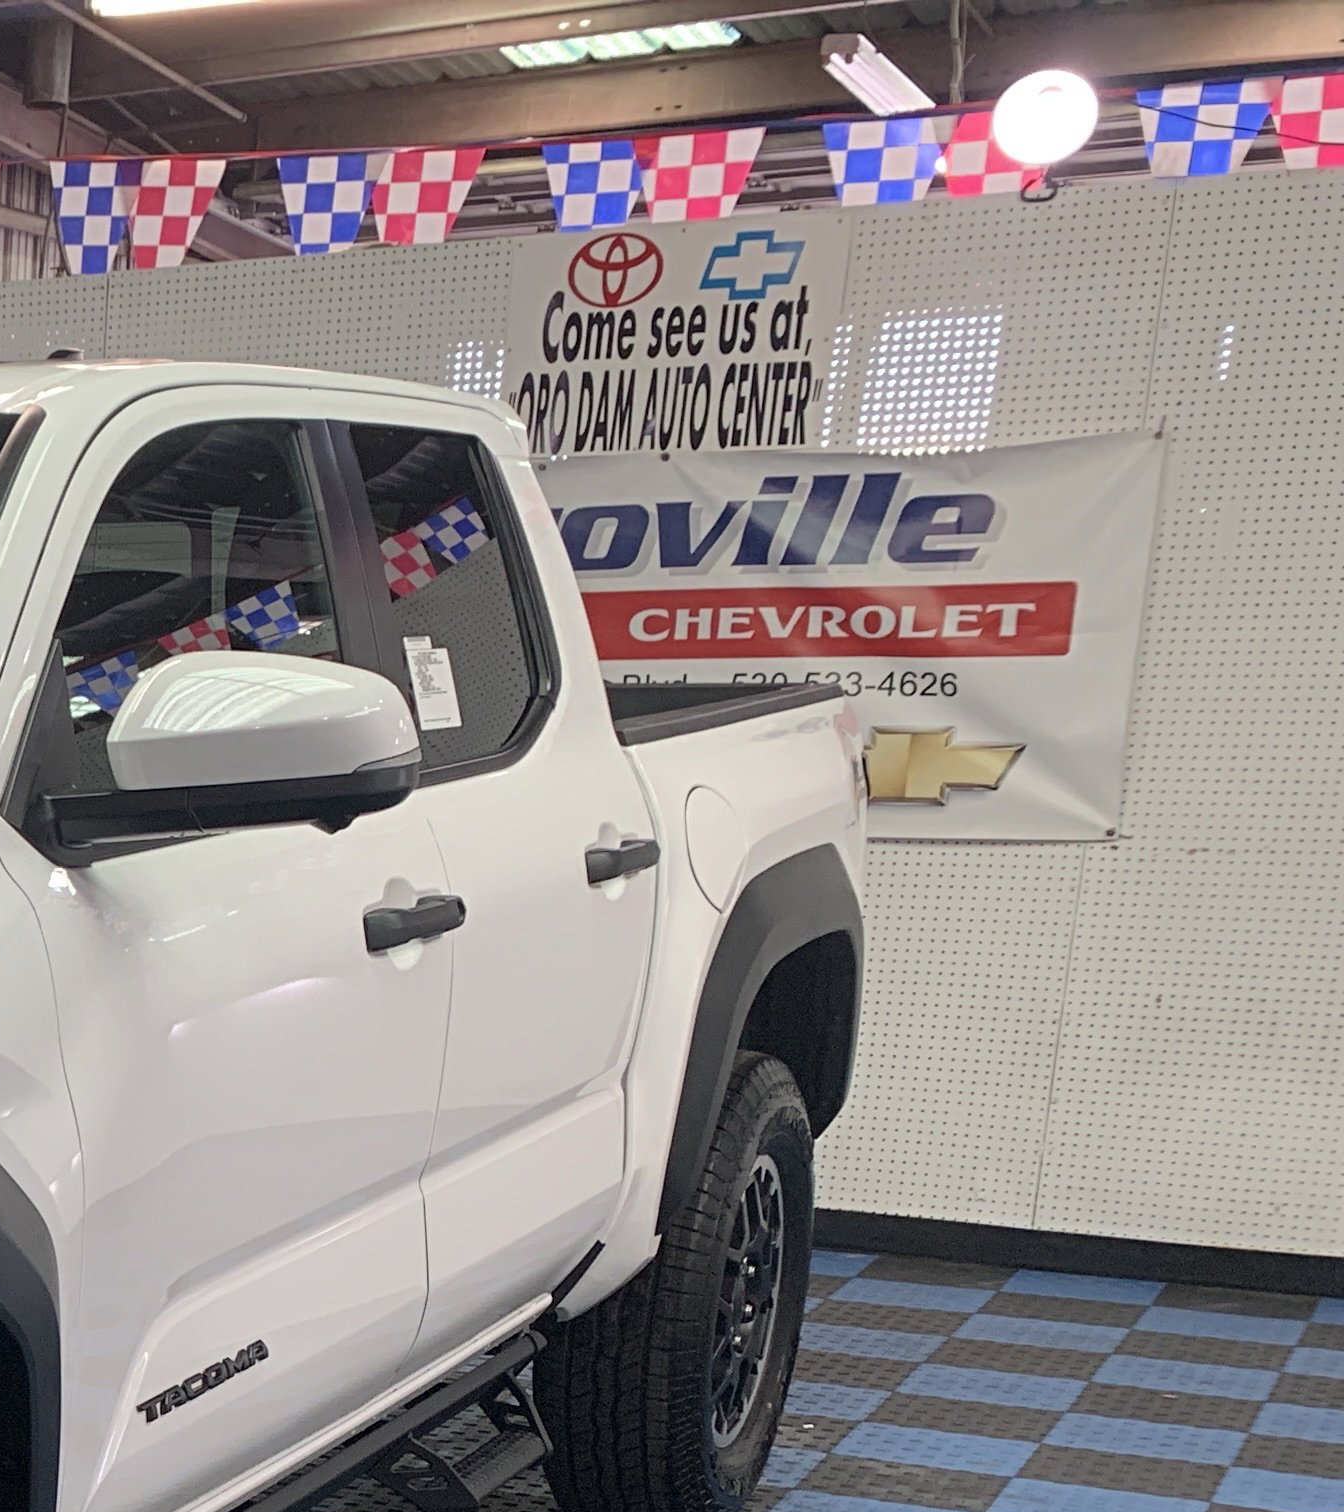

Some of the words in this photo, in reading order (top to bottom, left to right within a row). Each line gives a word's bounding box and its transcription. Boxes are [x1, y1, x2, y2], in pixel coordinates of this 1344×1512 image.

[542, 292, 636, 363] Come
[647, 312, 705, 358] see
[720, 301, 758, 352] us
[769, 286, 812, 359] at,
[574, 369, 636, 452] DAM
[639, 363, 711, 450] AUTO
[718, 361, 823, 449] CENTER"
[555, 472, 996, 571] oville
[628, 603, 1035, 642] CHEVROLET
[733, 672, 958, 697] 3-4626
[135, 1339, 269, 1423] TACOMA
